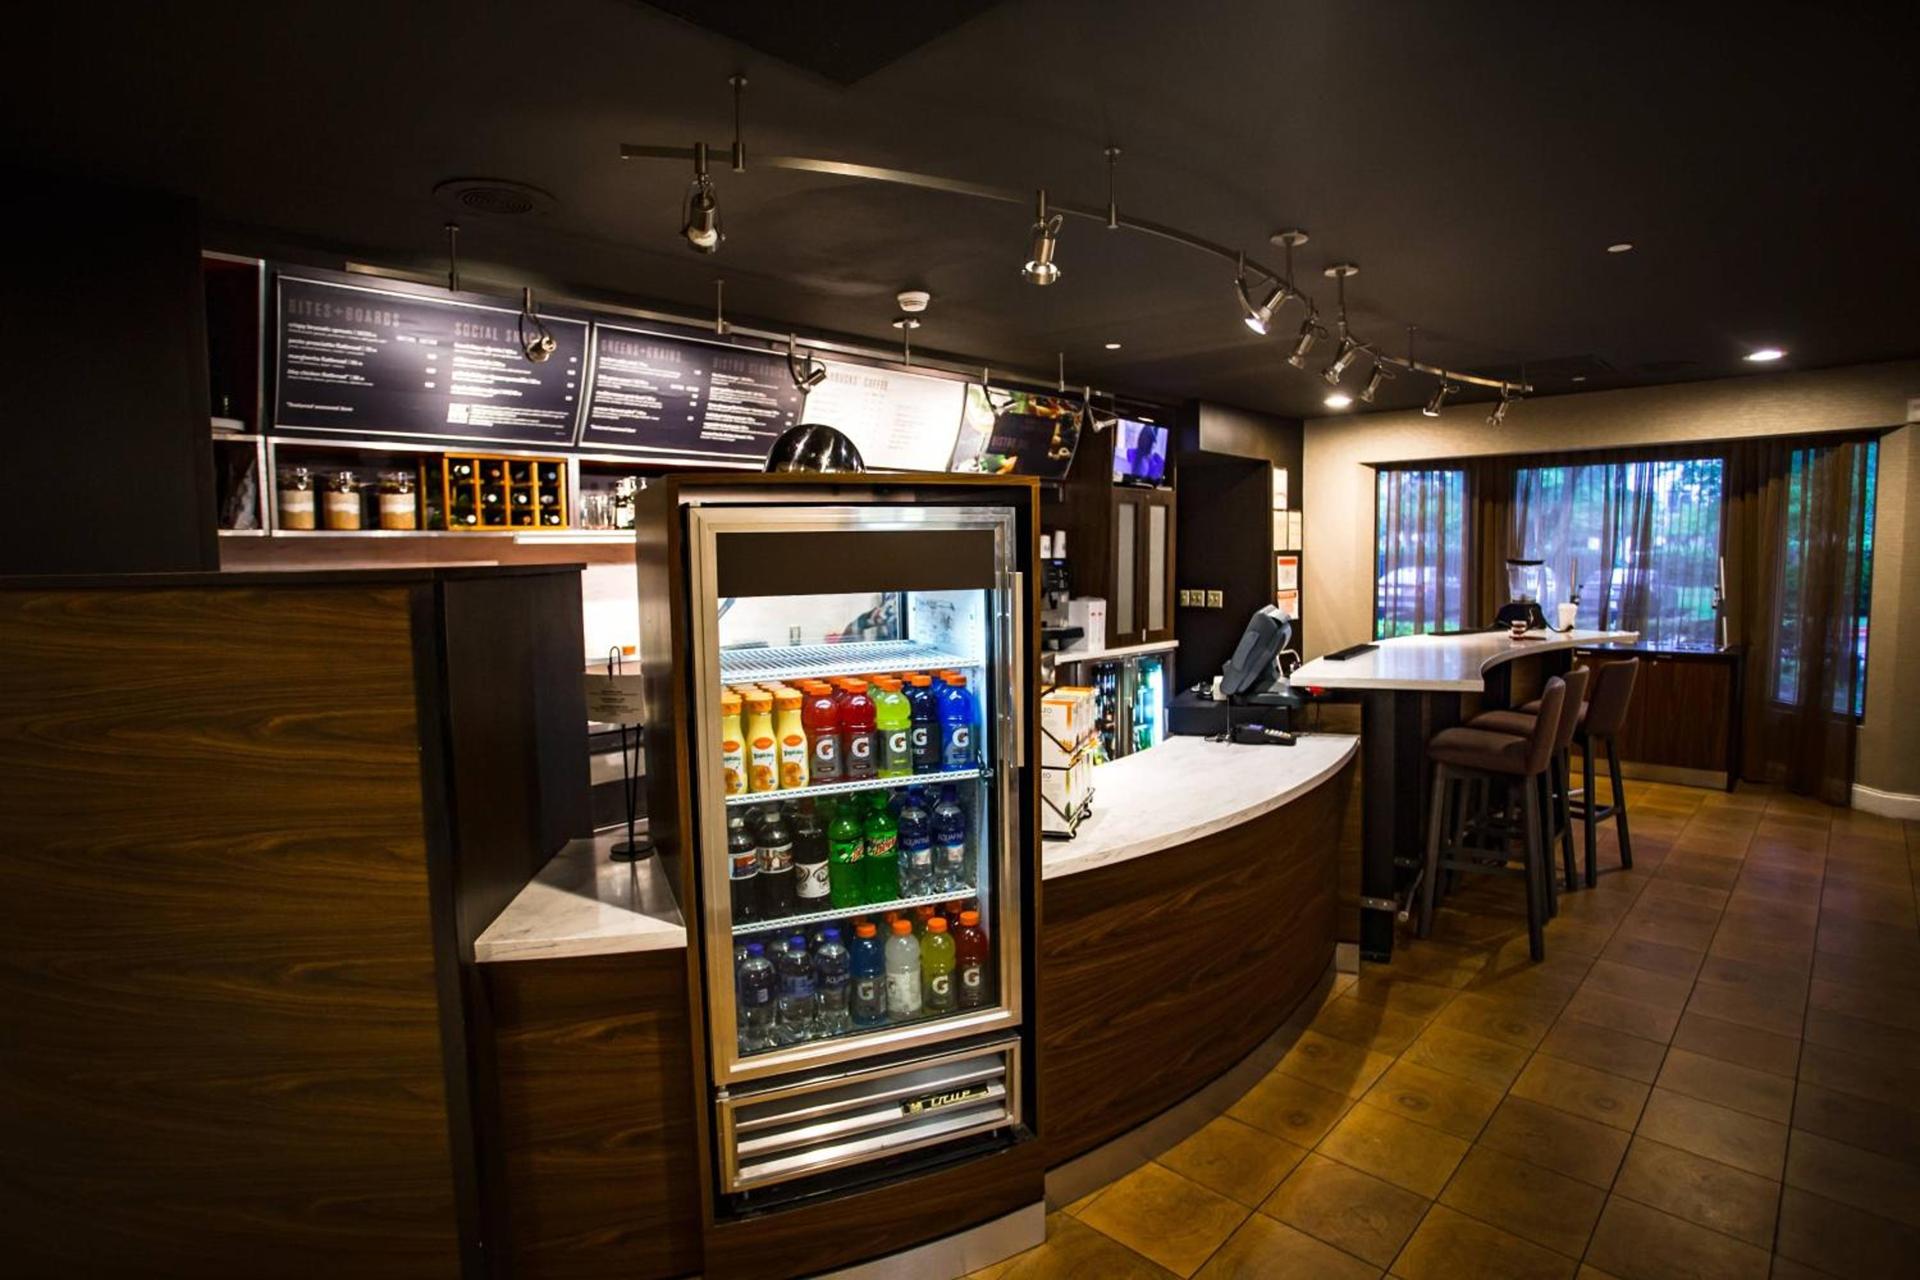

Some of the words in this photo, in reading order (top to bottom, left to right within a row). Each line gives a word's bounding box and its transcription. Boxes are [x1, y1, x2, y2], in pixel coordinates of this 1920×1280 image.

[453, 321, 498, 341] SOCIAL
[889, 731, 907, 753] G
[912, 727, 928, 746] G
[951, 727, 969, 748] G
[815, 739, 834, 760] G
[851, 736, 870, 758] G
[932, 975, 949, 995] G
[963, 968, 980, 987] G
[857, 981, 874, 1001] G
